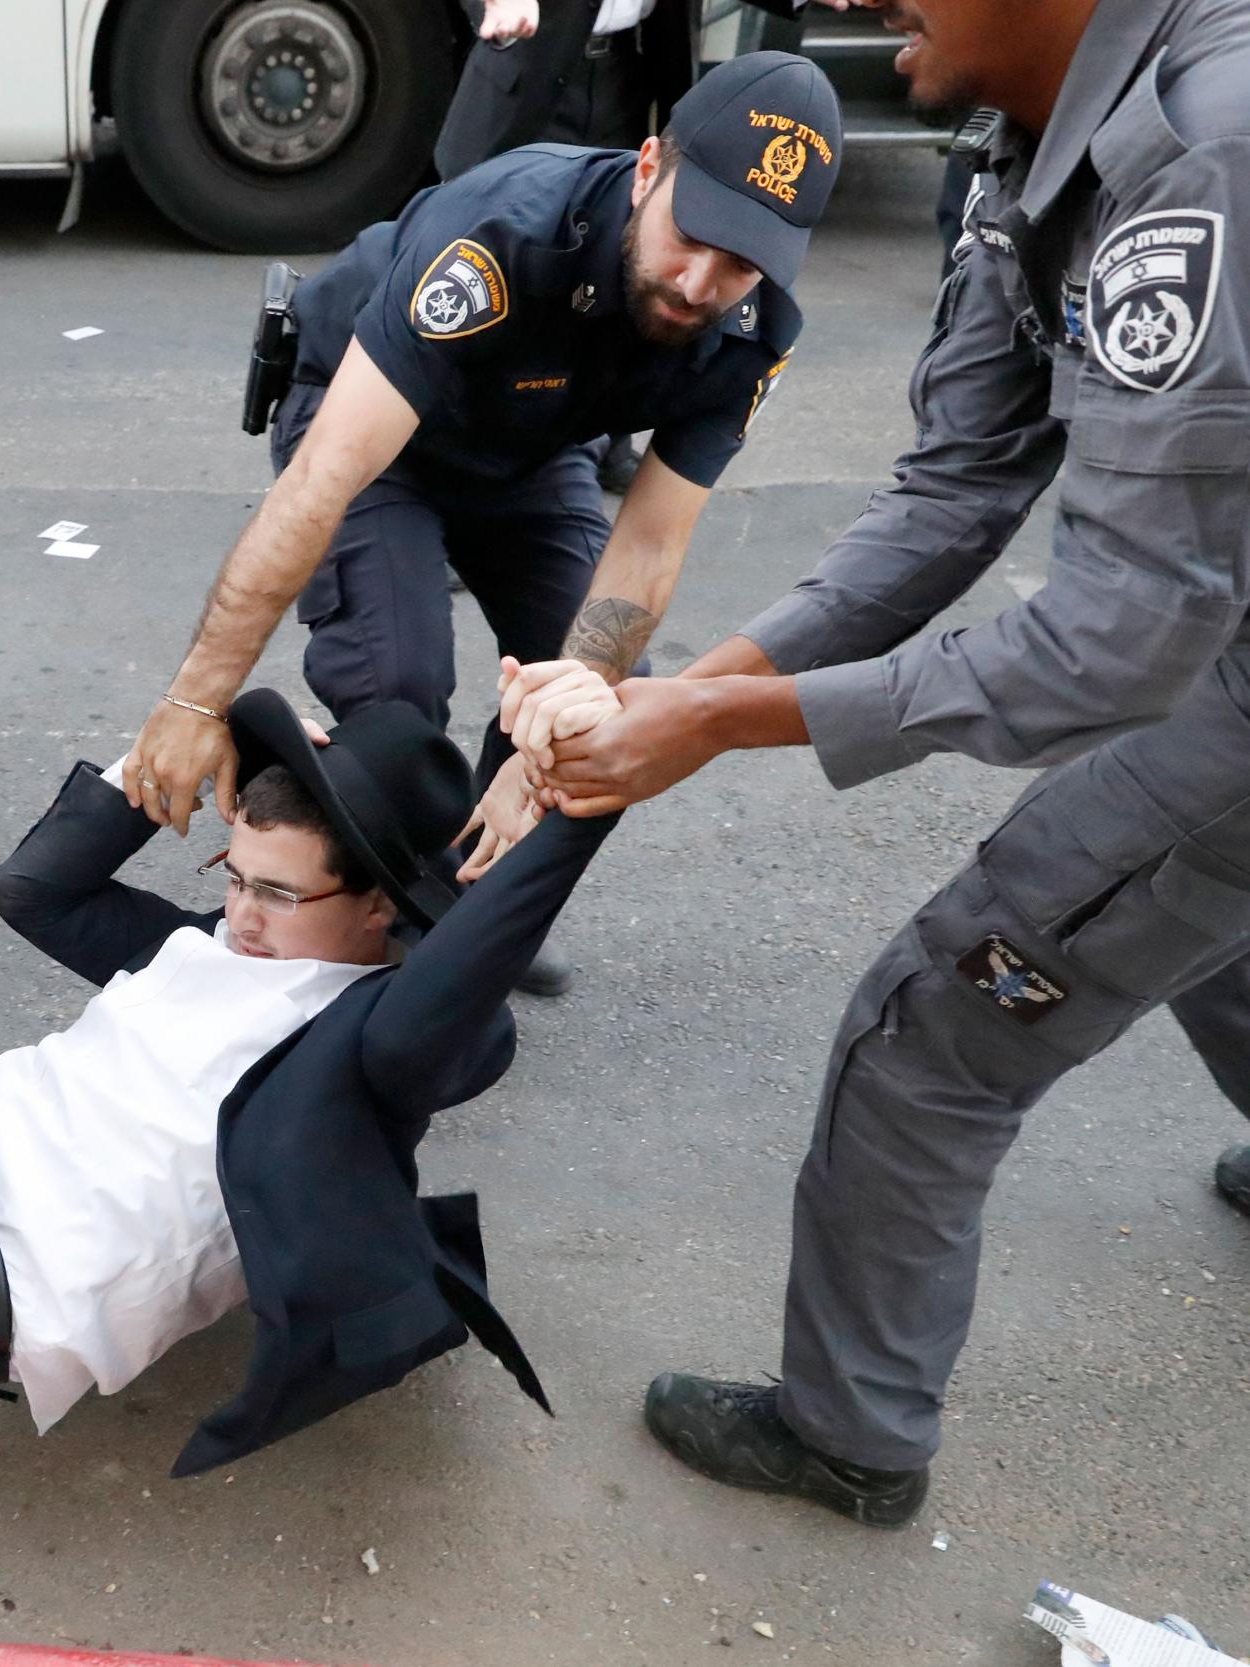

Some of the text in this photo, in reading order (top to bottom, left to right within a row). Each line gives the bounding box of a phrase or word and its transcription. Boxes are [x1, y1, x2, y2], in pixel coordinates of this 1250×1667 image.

[749, 109, 833, 165] משטרת ישראל
[746, 167, 798, 204] POLICE
[457, 245, 502, 312] משטרת ישראל
[1094, 227, 1207, 280] משטרת ישראל
[991, 939, 1065, 999] משטרת ישראל
